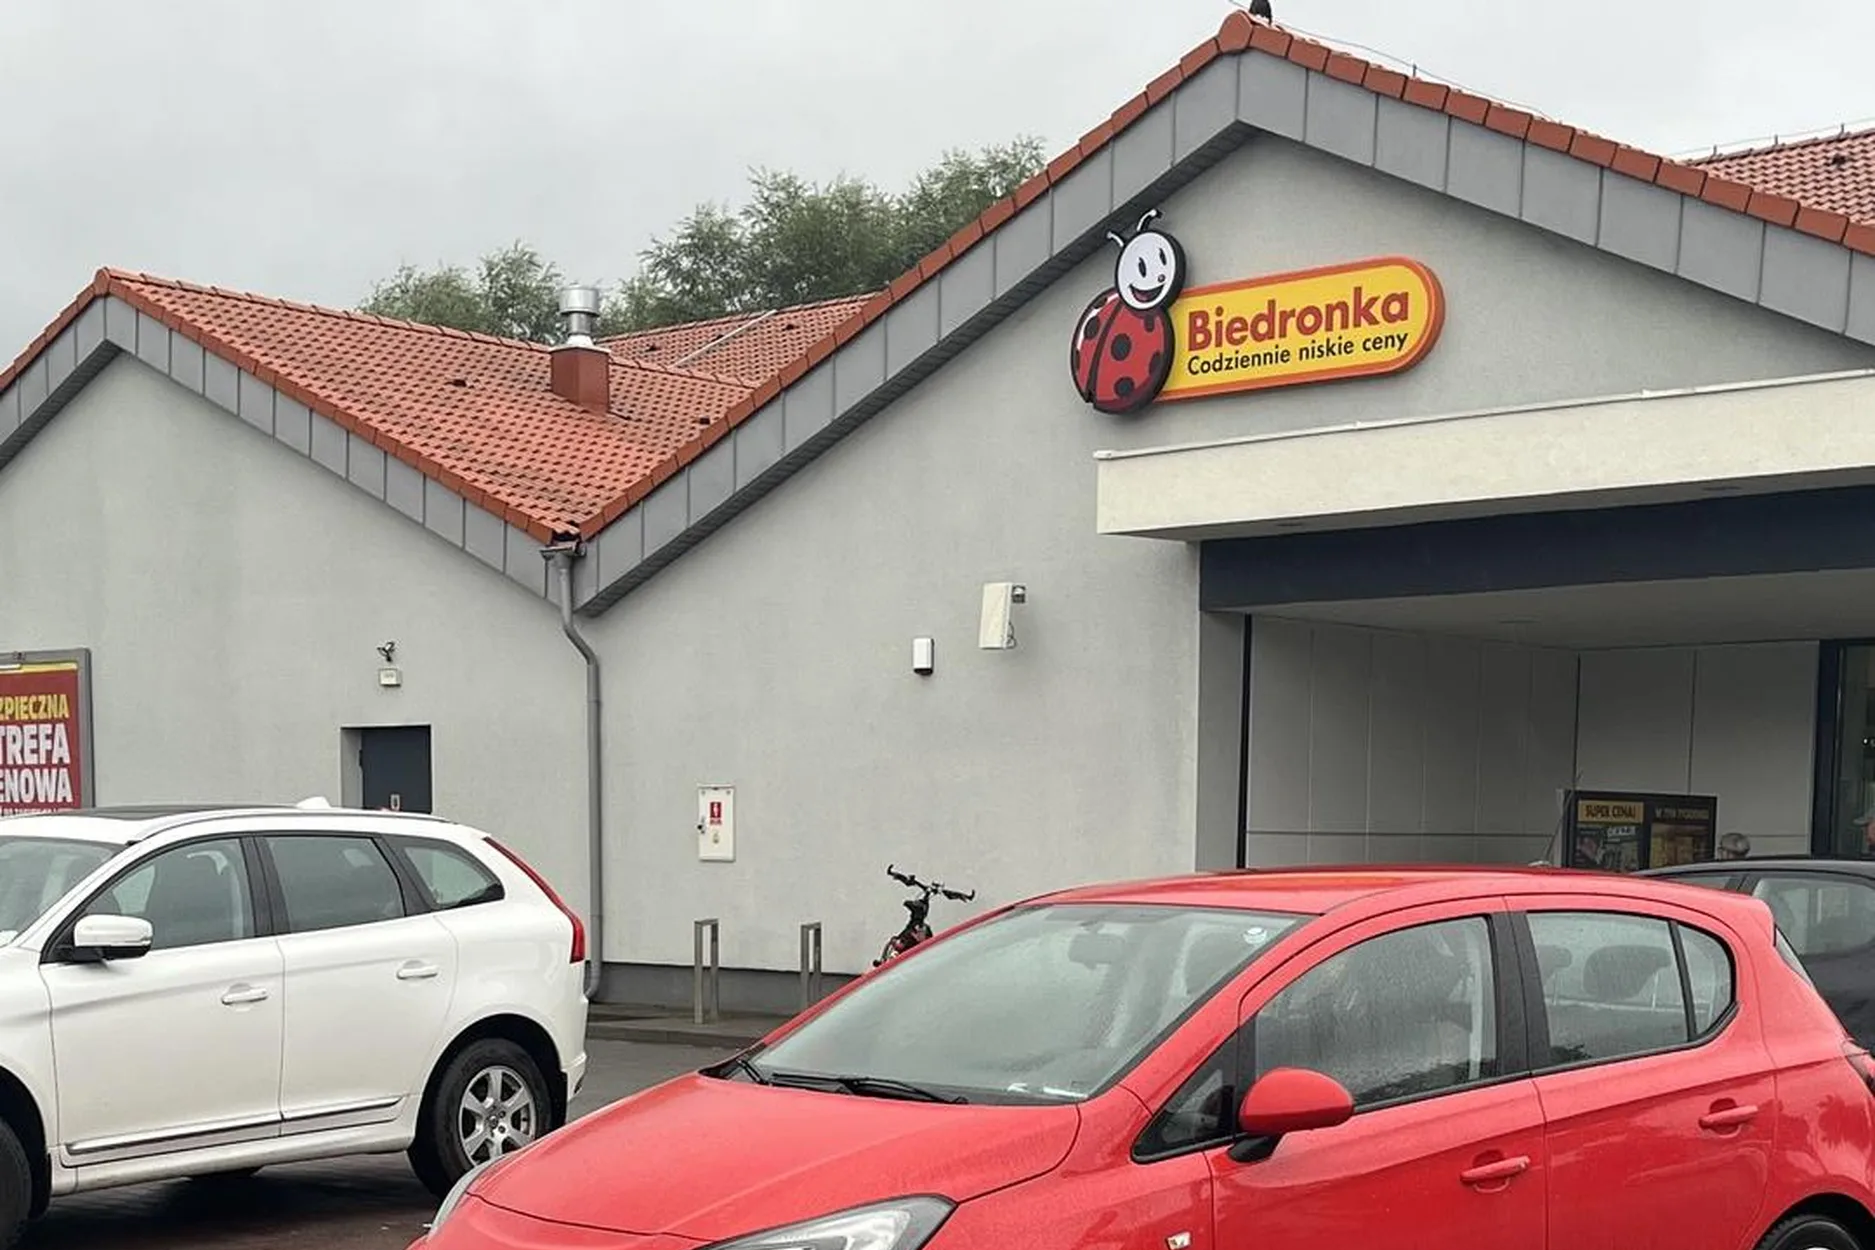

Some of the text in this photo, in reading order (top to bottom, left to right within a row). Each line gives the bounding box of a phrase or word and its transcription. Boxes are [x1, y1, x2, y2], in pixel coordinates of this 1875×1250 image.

[1188, 287, 1410, 352] Biedronka
[1187, 332, 1409, 376] Codziennie niskie ceny
